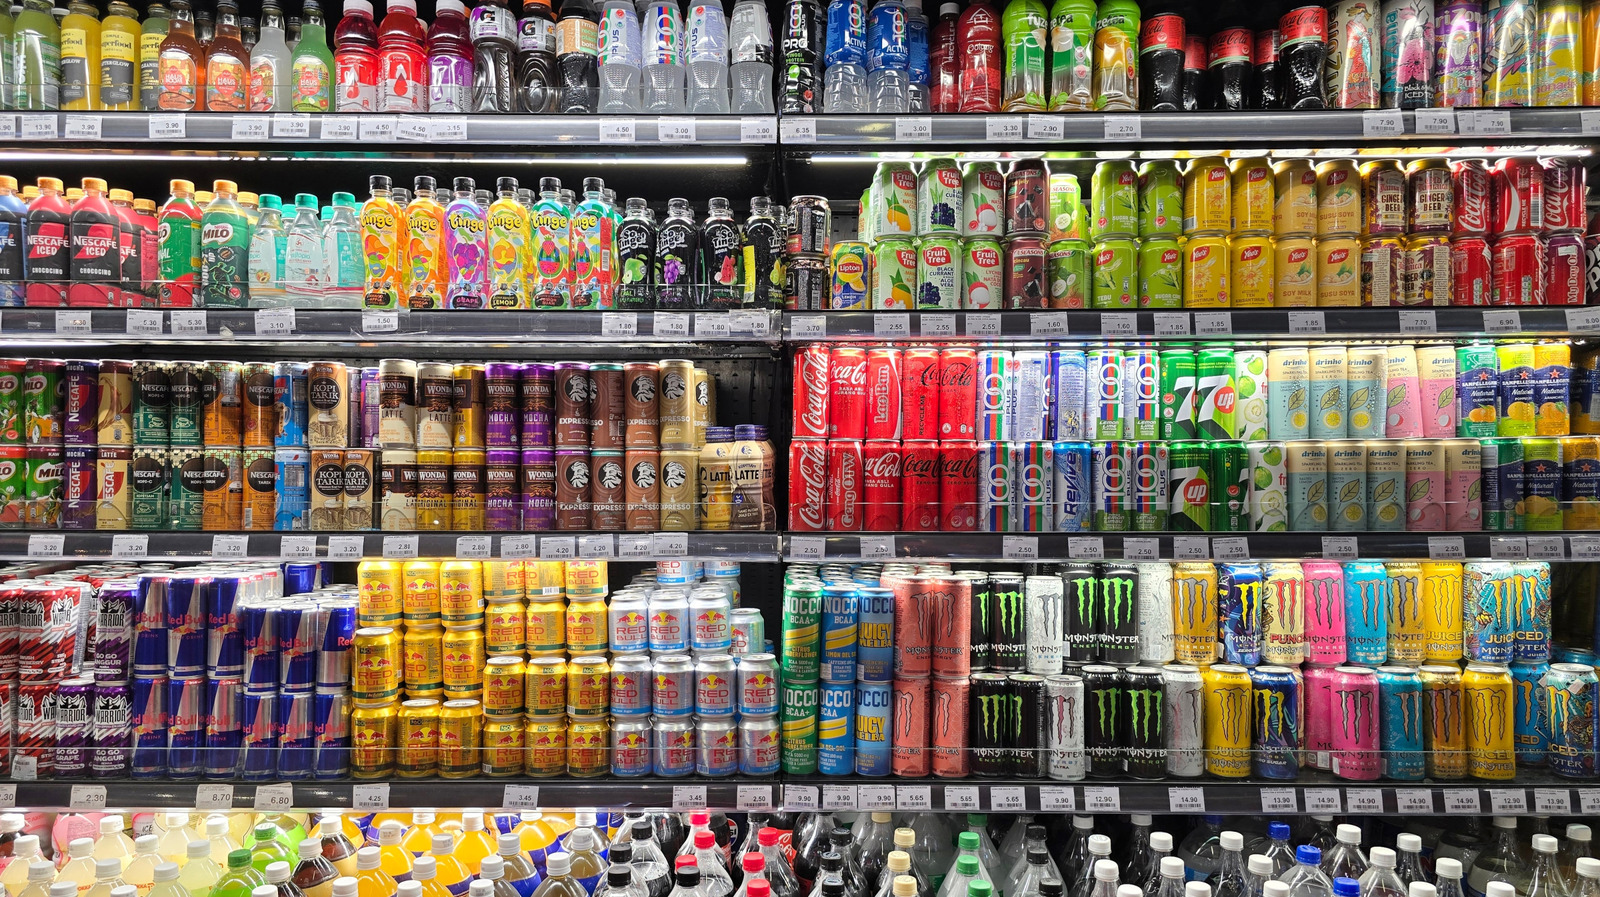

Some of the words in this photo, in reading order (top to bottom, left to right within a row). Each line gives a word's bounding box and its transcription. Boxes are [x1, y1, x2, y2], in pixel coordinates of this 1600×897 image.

[783, 39, 809, 48] PRO
[846, 40, 866, 48] ACTIVE
[887, 46, 908, 54] ACTIVE
[1404, 91, 1423, 99] ICED
[897, 172, 914, 182] Fruit
[899, 179, 914, 187] Tree
[1420, 193, 1445, 202] GINGER
[1423, 203, 1442, 211] BEER
[203, 229, 228, 240] MILO
[73, 234, 118, 249] NESCAFÉ
[37, 246, 58, 255] ICED
[86, 247, 106, 257] ICED
[926, 249, 946, 258] Fruit
[976, 251, 996, 259] Fruit
[1244, 251, 1259, 259] Yeo's
[928, 255, 945, 263] Tree
[1291, 251, 1306, 260] Yeo's
[1330, 252, 1346, 261] Yeo's
[32, 267, 63, 275] CHOCOCINO
[80, 268, 111, 276] CHOCOCINO
[839, 265, 861, 274] Lipton
[313, 385, 336, 393] KOPI
[488, 384, 515, 393] WONDA
[919, 394, 925, 403] ME
[983, 373, 1005, 417] 100
[1217, 392, 1233, 407] up
[489, 413, 514, 421] MOCHA
[1334, 449, 1362, 457] drinho
[419, 471, 445, 480] WONDA
[487, 470, 514, 479] WONDA
[735, 470, 759, 479] LATTE
[1101, 454, 1126, 500] 100
[1187, 485, 1206, 501] up
[361, 594, 393, 603] RED
[361, 601, 393, 609] BULL
[616, 626, 646, 635] RED
[859, 622, 892, 639] JUICY
[616, 633, 646, 641] BULL
[697, 689, 729, 698] RED
[697, 696, 728, 704] BULL
[96, 709, 126, 723] WARRIOR
[211, 793, 231, 801] 8.70
